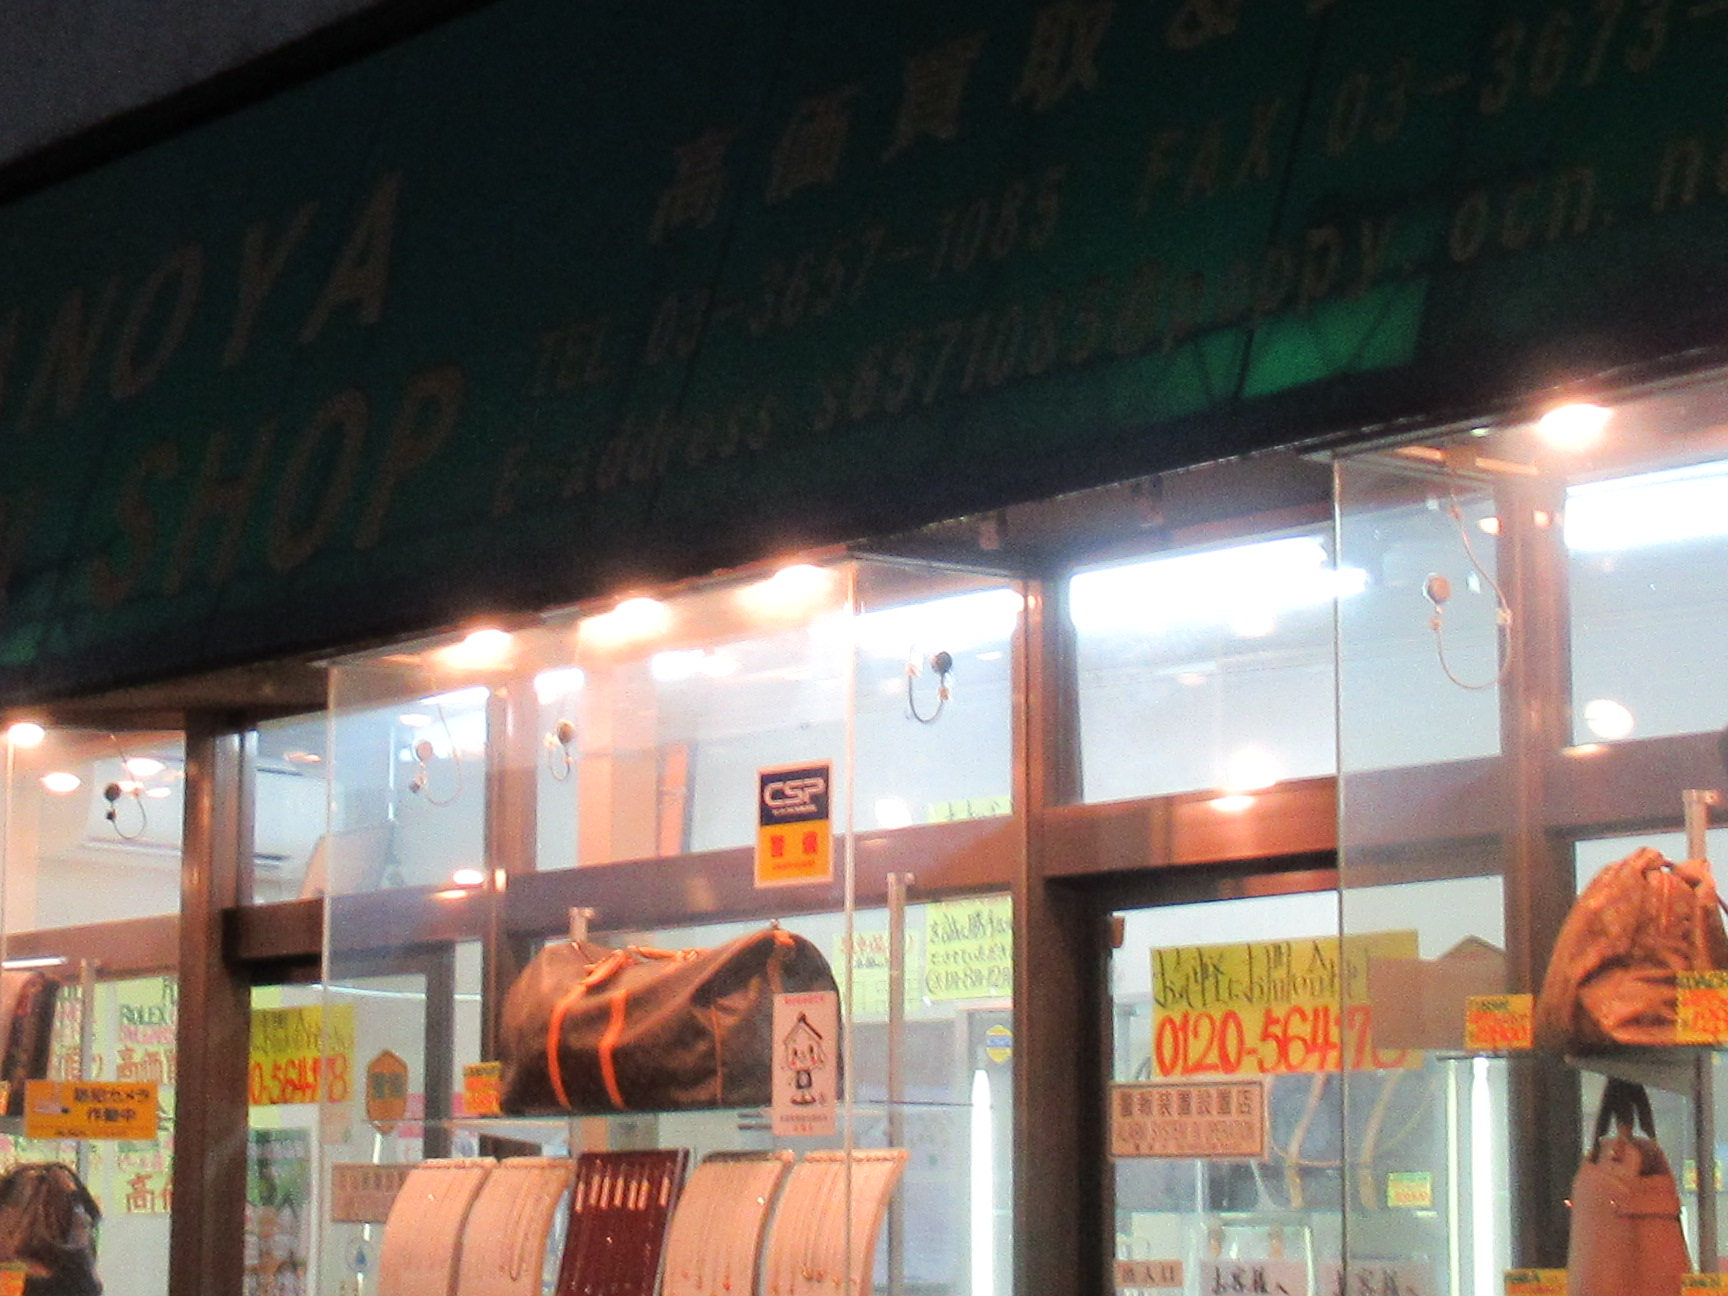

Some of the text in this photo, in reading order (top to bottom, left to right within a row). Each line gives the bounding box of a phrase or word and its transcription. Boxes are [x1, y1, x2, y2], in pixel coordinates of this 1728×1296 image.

[1135, 96, 1278, 219] FAX
[87, 360, 465, 610] SHOP
[763, 776, 827, 808] CSP
